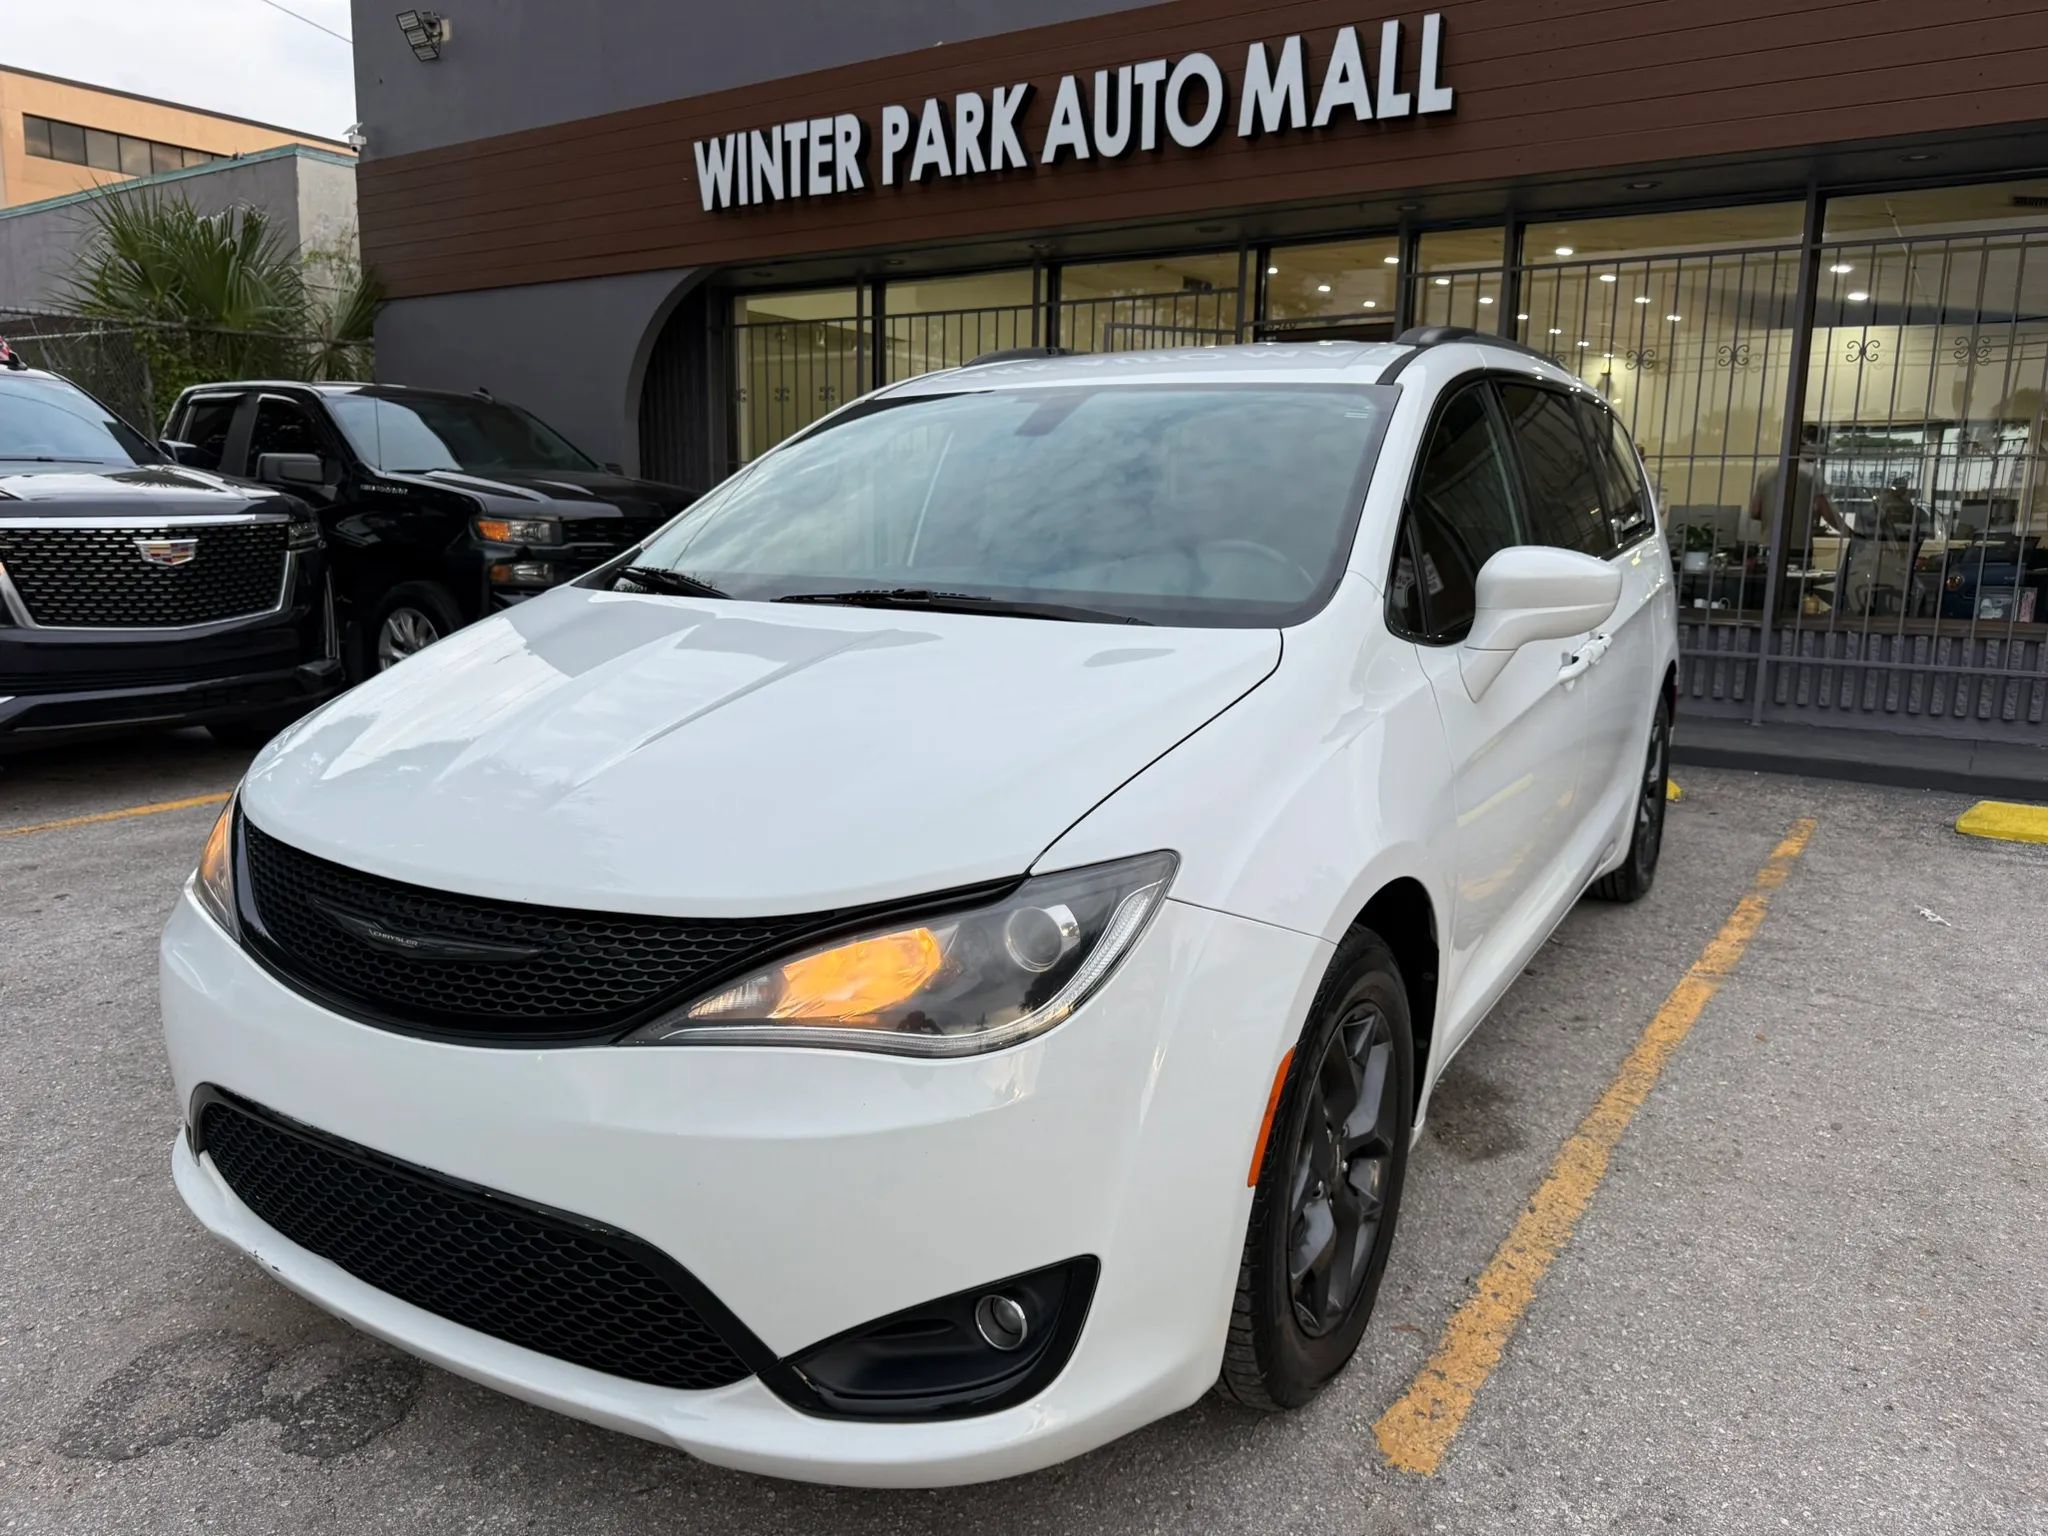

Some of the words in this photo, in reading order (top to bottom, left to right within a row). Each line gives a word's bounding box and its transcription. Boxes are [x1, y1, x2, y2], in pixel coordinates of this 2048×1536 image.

[693, 113, 864, 211] WINTER
[882, 83, 1028, 185] PARK
[1041, 52, 1223, 164] AUTO
[1237, 12, 1453, 137] MALL
